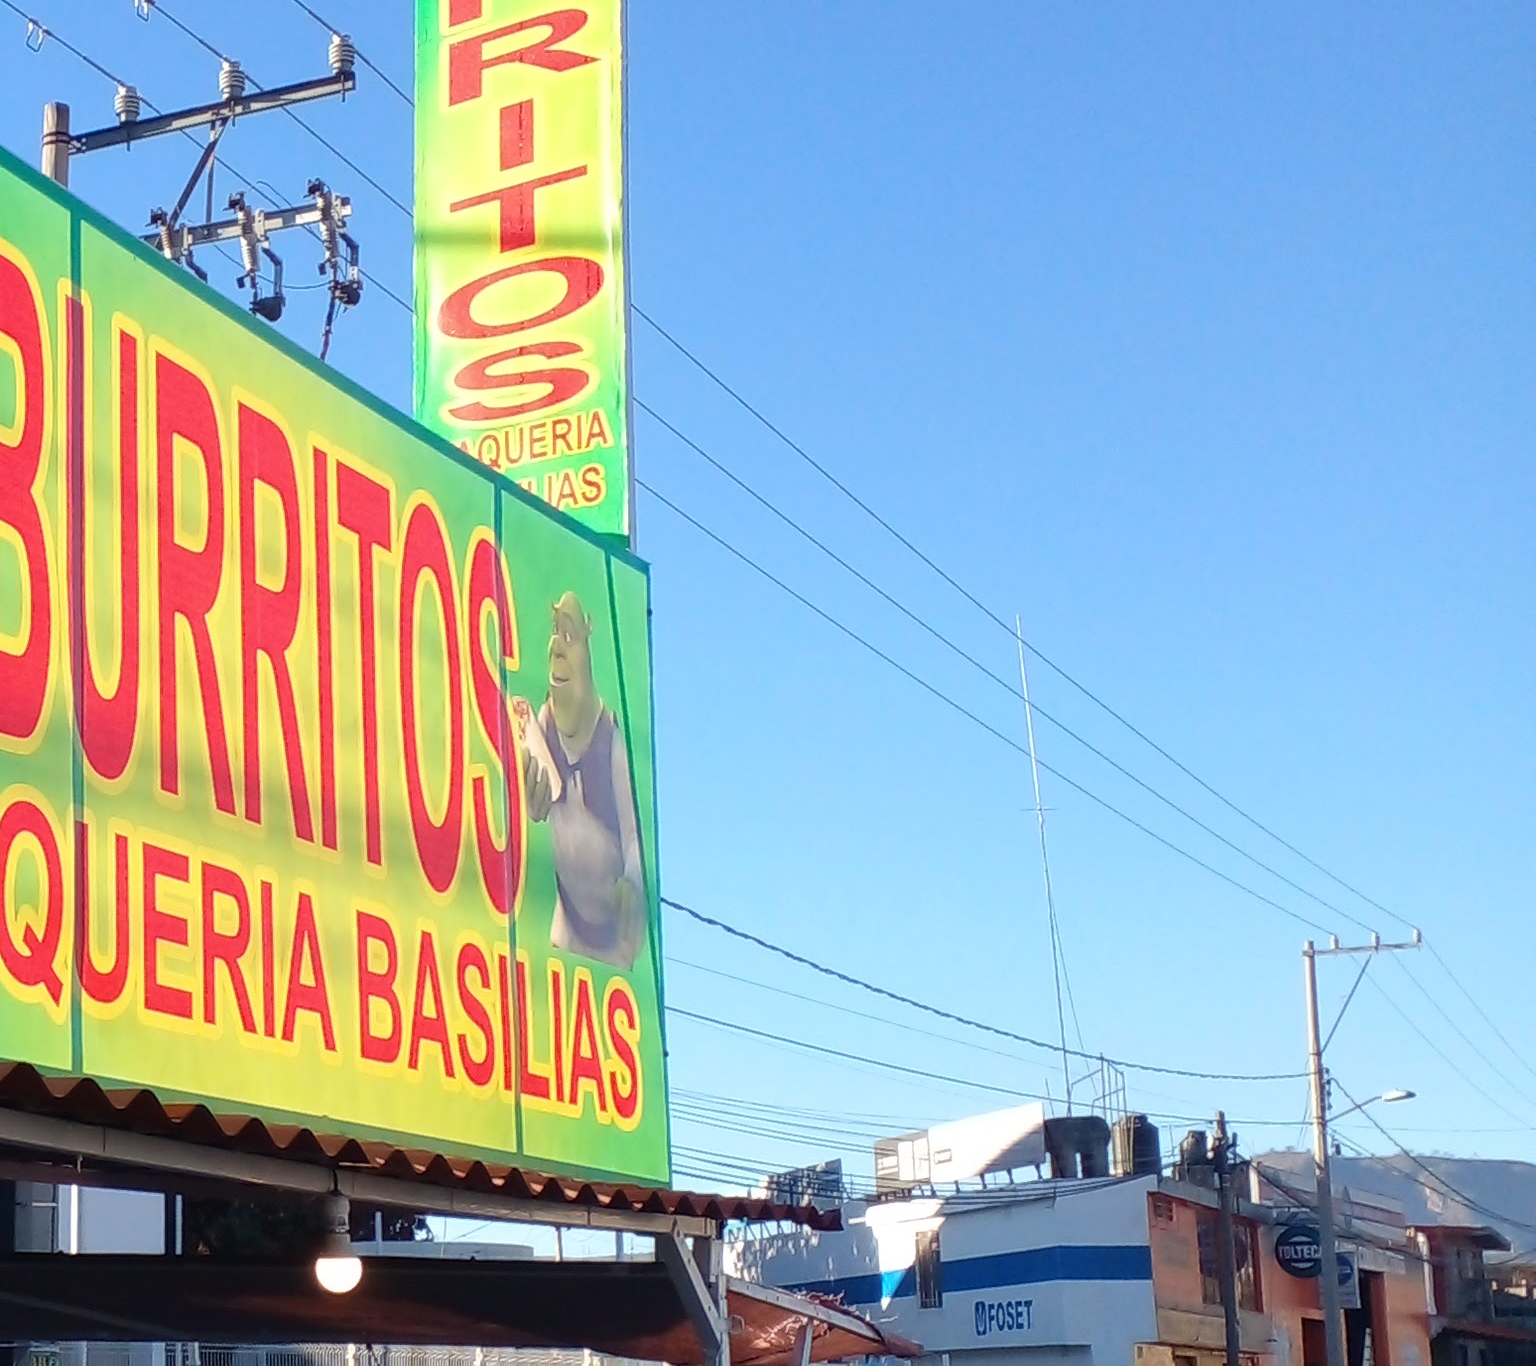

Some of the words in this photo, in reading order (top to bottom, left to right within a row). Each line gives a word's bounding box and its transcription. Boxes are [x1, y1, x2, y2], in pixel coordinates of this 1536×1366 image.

[356, 910, 639, 1121] BASILIAS
[1278, 1244, 1321, 1259] TOLTEC
[987, 1299, 1033, 1333] FOSET
